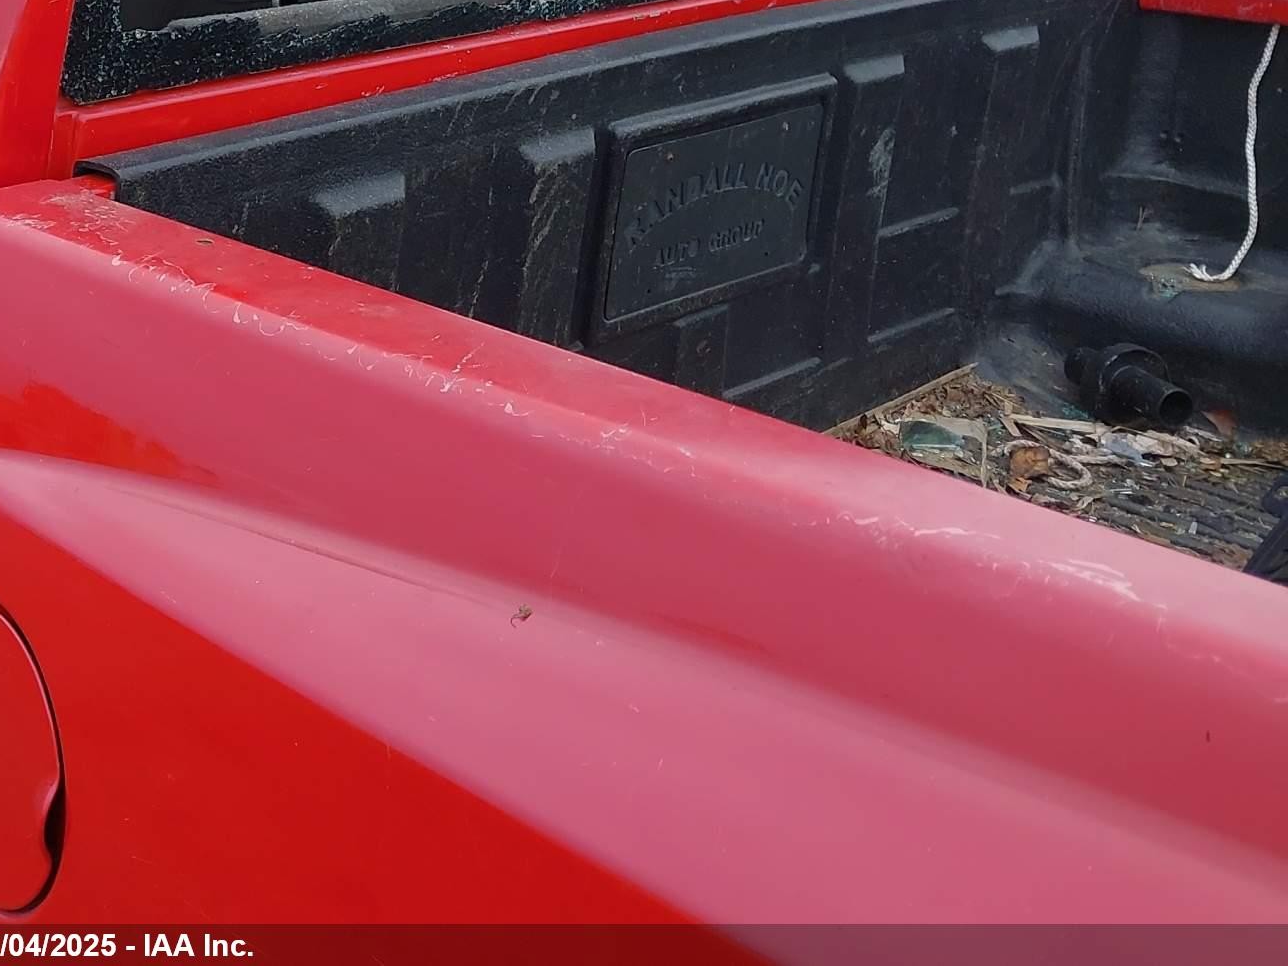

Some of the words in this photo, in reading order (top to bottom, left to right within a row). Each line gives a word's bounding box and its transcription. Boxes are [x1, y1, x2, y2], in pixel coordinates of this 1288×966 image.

[625, 162, 748, 251] RANDALL
[755, 162, 804, 209] NOE
[655, 236, 701, 267] AUTO
[708, 218, 765, 253] GROUP
